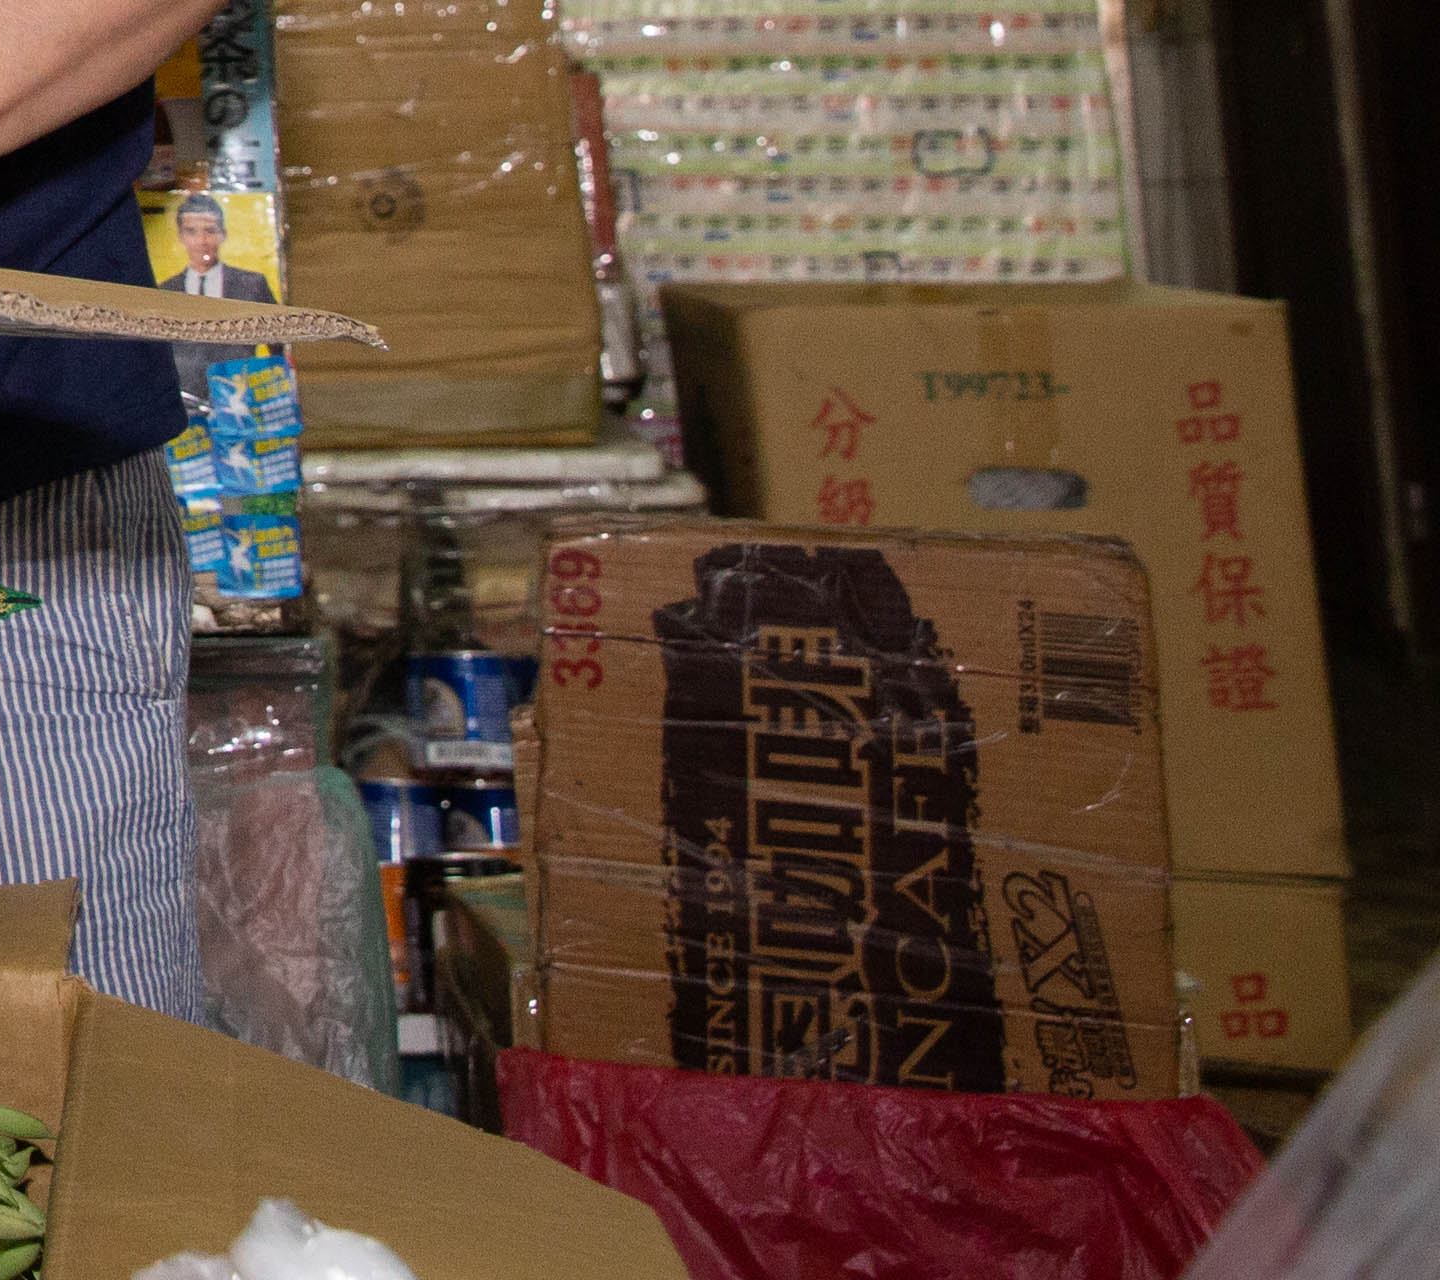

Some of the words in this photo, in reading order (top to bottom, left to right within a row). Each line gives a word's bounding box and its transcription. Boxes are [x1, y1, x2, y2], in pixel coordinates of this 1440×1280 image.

[811, 386, 878, 526] 分級
[1174, 378, 1280, 716] 品質保證
[704, 935, 737, 1076] SINCE
[1219, 972, 1290, 1040] 品
